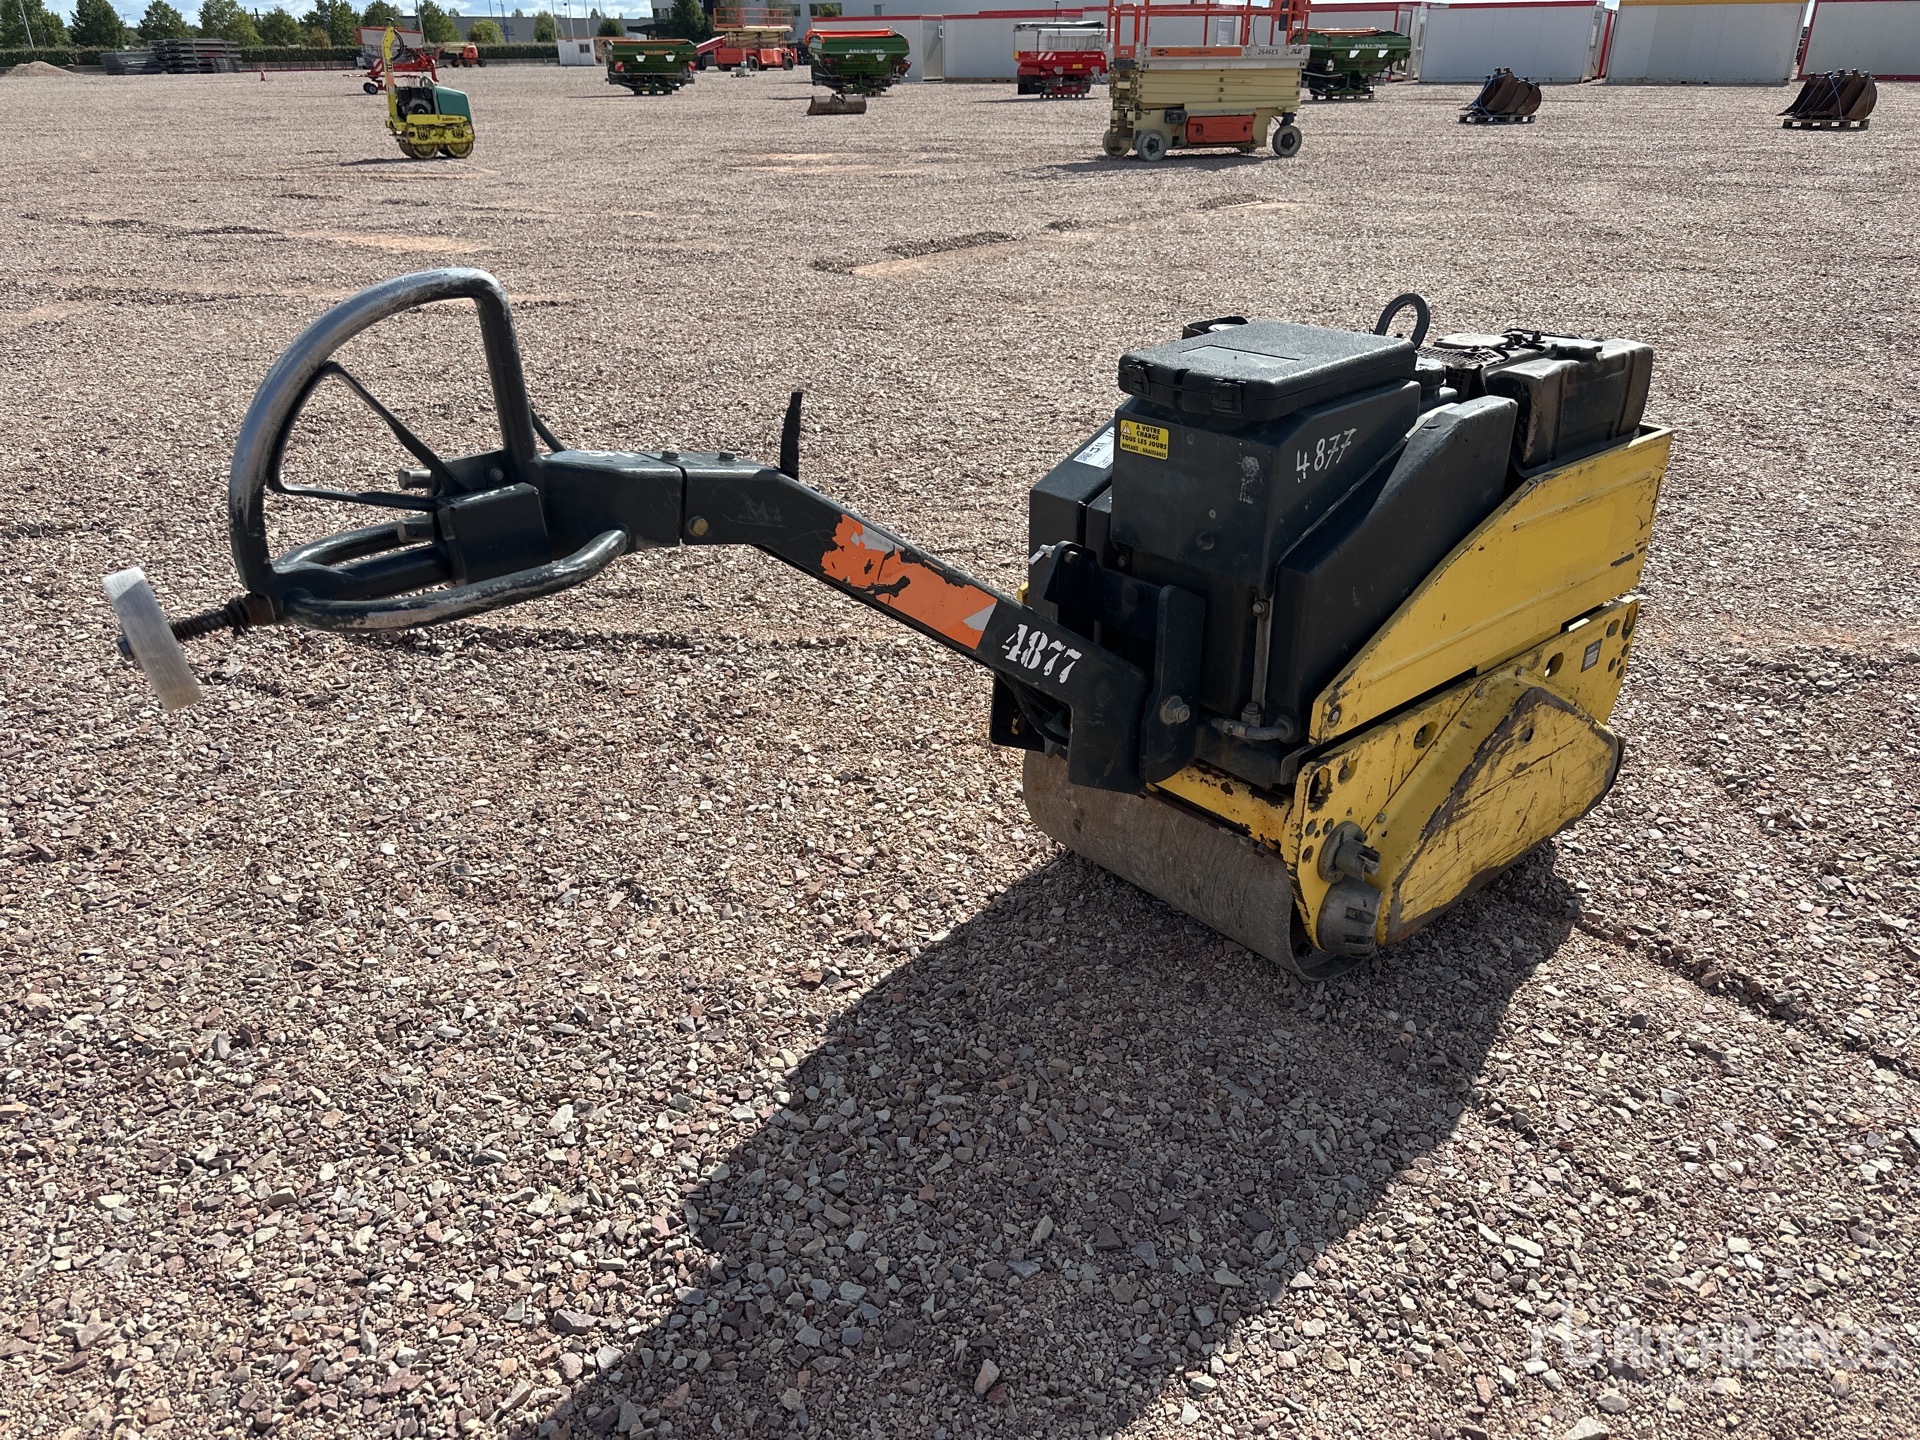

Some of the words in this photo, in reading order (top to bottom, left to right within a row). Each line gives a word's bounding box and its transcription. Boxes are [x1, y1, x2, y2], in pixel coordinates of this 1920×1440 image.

[1136, 431, 1159, 440] CHARGE
[1141, 426, 1160, 434] VOTRE
[1122, 434, 1136, 442] TOUS
[1149, 441, 1167, 450] JOURS
[1296, 428, 1357, 480] 4877
[1001, 624, 1082, 684] 4877
